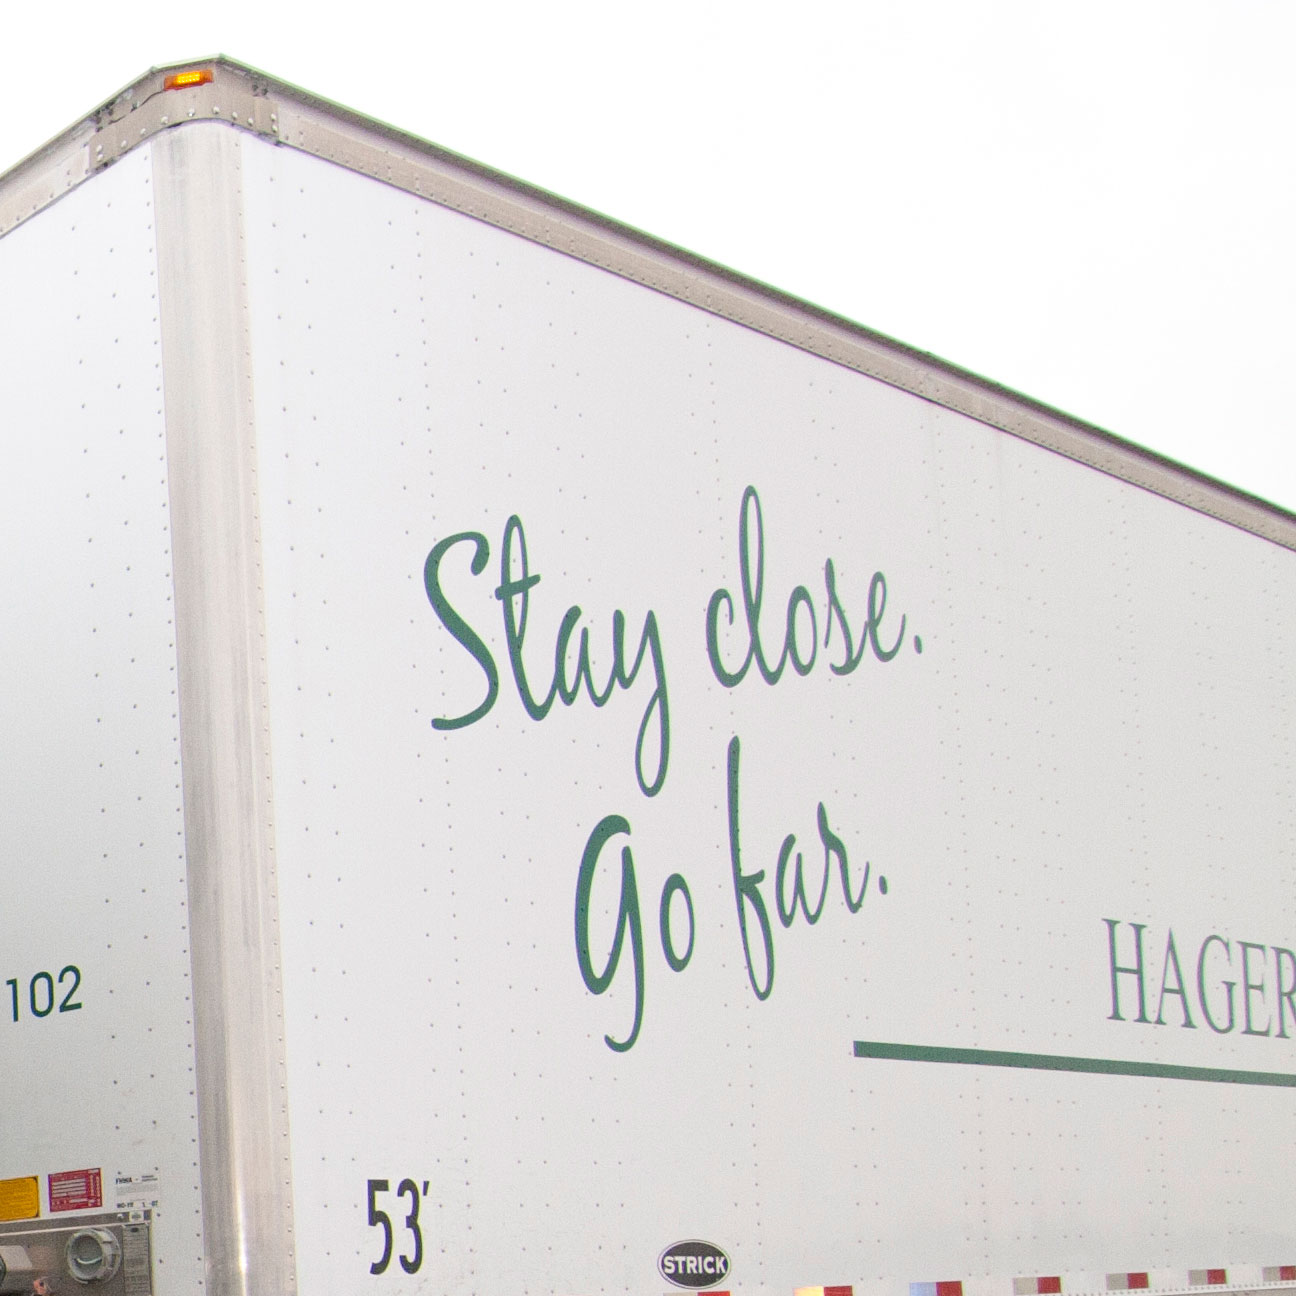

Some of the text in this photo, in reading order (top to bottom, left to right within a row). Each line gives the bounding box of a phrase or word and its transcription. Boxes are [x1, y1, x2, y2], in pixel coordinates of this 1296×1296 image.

[423, 485, 924, 798] Stay close.
[727, 735, 889, 1002] far.
[5, 964, 83, 1023] 102
[1101, 917, 1296, 1039] HAGER
[367, 1178, 430, 1276] 53'
[663, 1255, 727, 1274] STRICK
